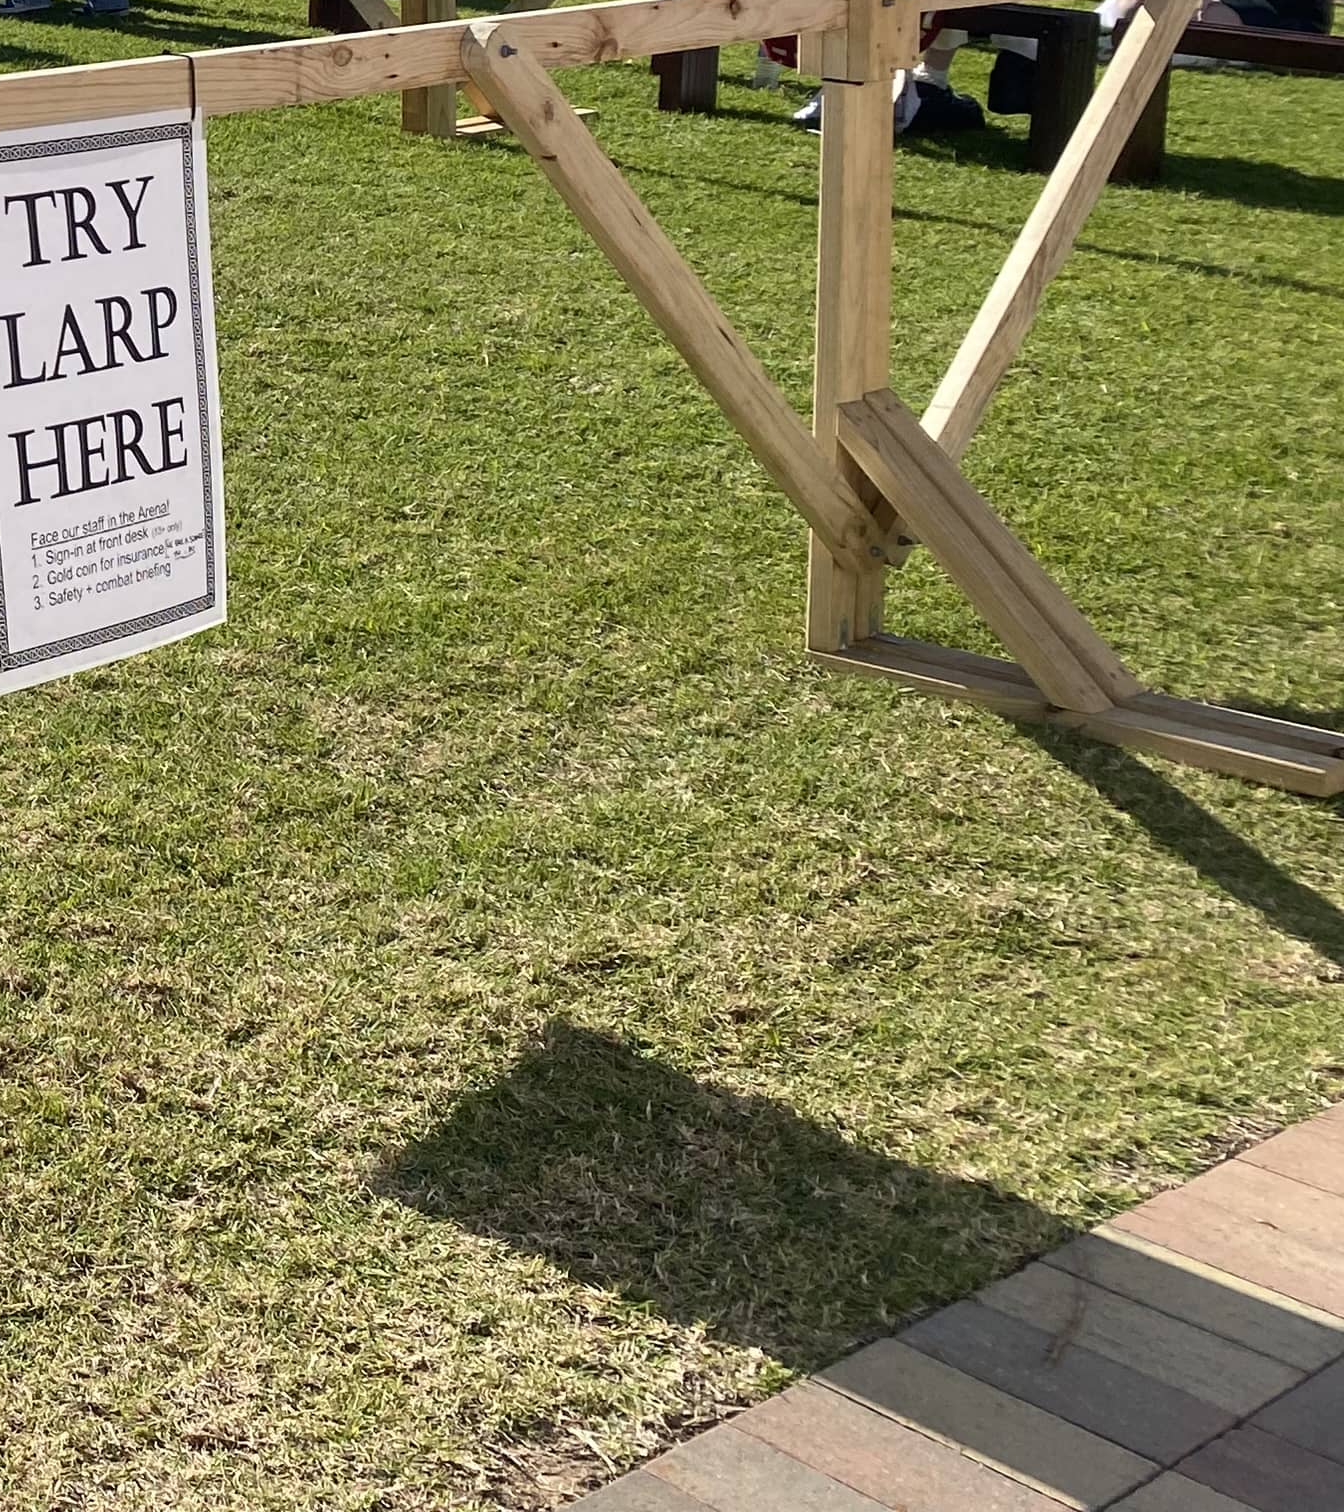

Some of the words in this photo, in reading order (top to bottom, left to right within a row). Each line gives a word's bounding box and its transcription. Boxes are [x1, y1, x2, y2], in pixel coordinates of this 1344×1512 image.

[4, 176, 155, 268] TRY
[8, 397, 187, 507] HERE
[31, 531, 59, 547] Face
[62, 527, 79, 539] our
[82, 517, 105, 535] staff
[107, 516, 117, 528] in
[119, 510, 136, 526] the
[138, 499, 170, 520] Arena!
[31, 554, 42, 568] 1.
[46, 545, 83, 566] Sign-in
[86, 542, 97, 554] at
[99, 535, 122, 552] front
[126, 526, 149, 544] desk
[32, 575, 41, 589] 2.
[47, 567, 73, 585] Gold
[76, 563, 98, 578] coin
[100, 557, 115, 572] for
[117, 544, 165, 568] insurance
[34, 595, 44, 610] 3.
[48, 587, 83, 606] Safety
[95, 573, 134, 594] combat
[136, 562, 172, 583] briefing
